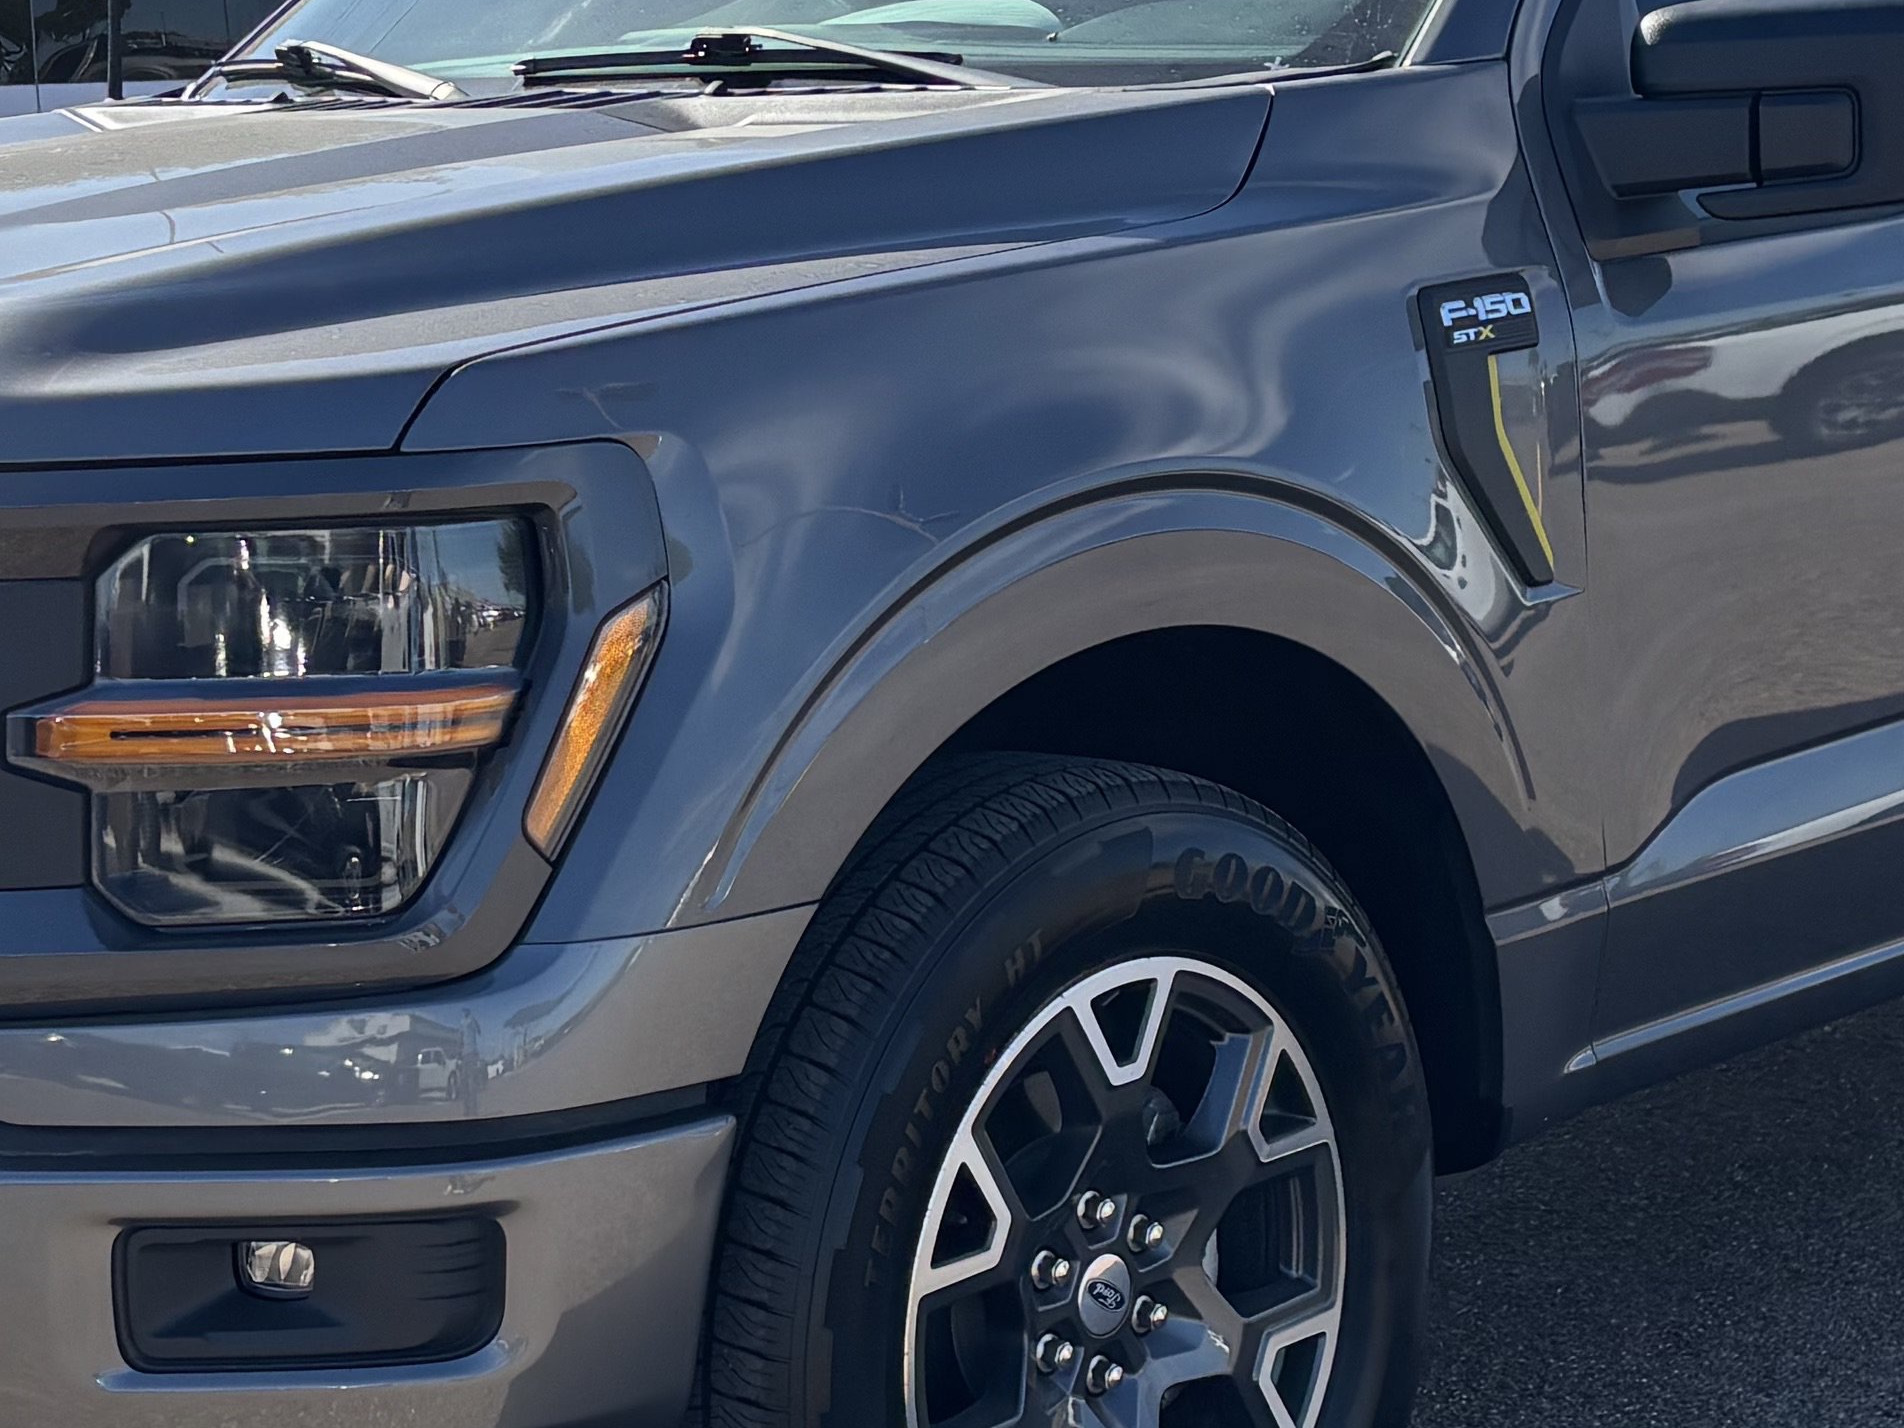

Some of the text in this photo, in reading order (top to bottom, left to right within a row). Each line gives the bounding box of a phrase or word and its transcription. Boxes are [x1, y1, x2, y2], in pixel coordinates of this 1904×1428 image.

[1439, 291, 1532, 327] F-150
[1453, 324, 1496, 344] STX
[1173, 847, 1417, 1123] GOODYEAR
[862, 927, 1045, 1289] TERRITORY HT
